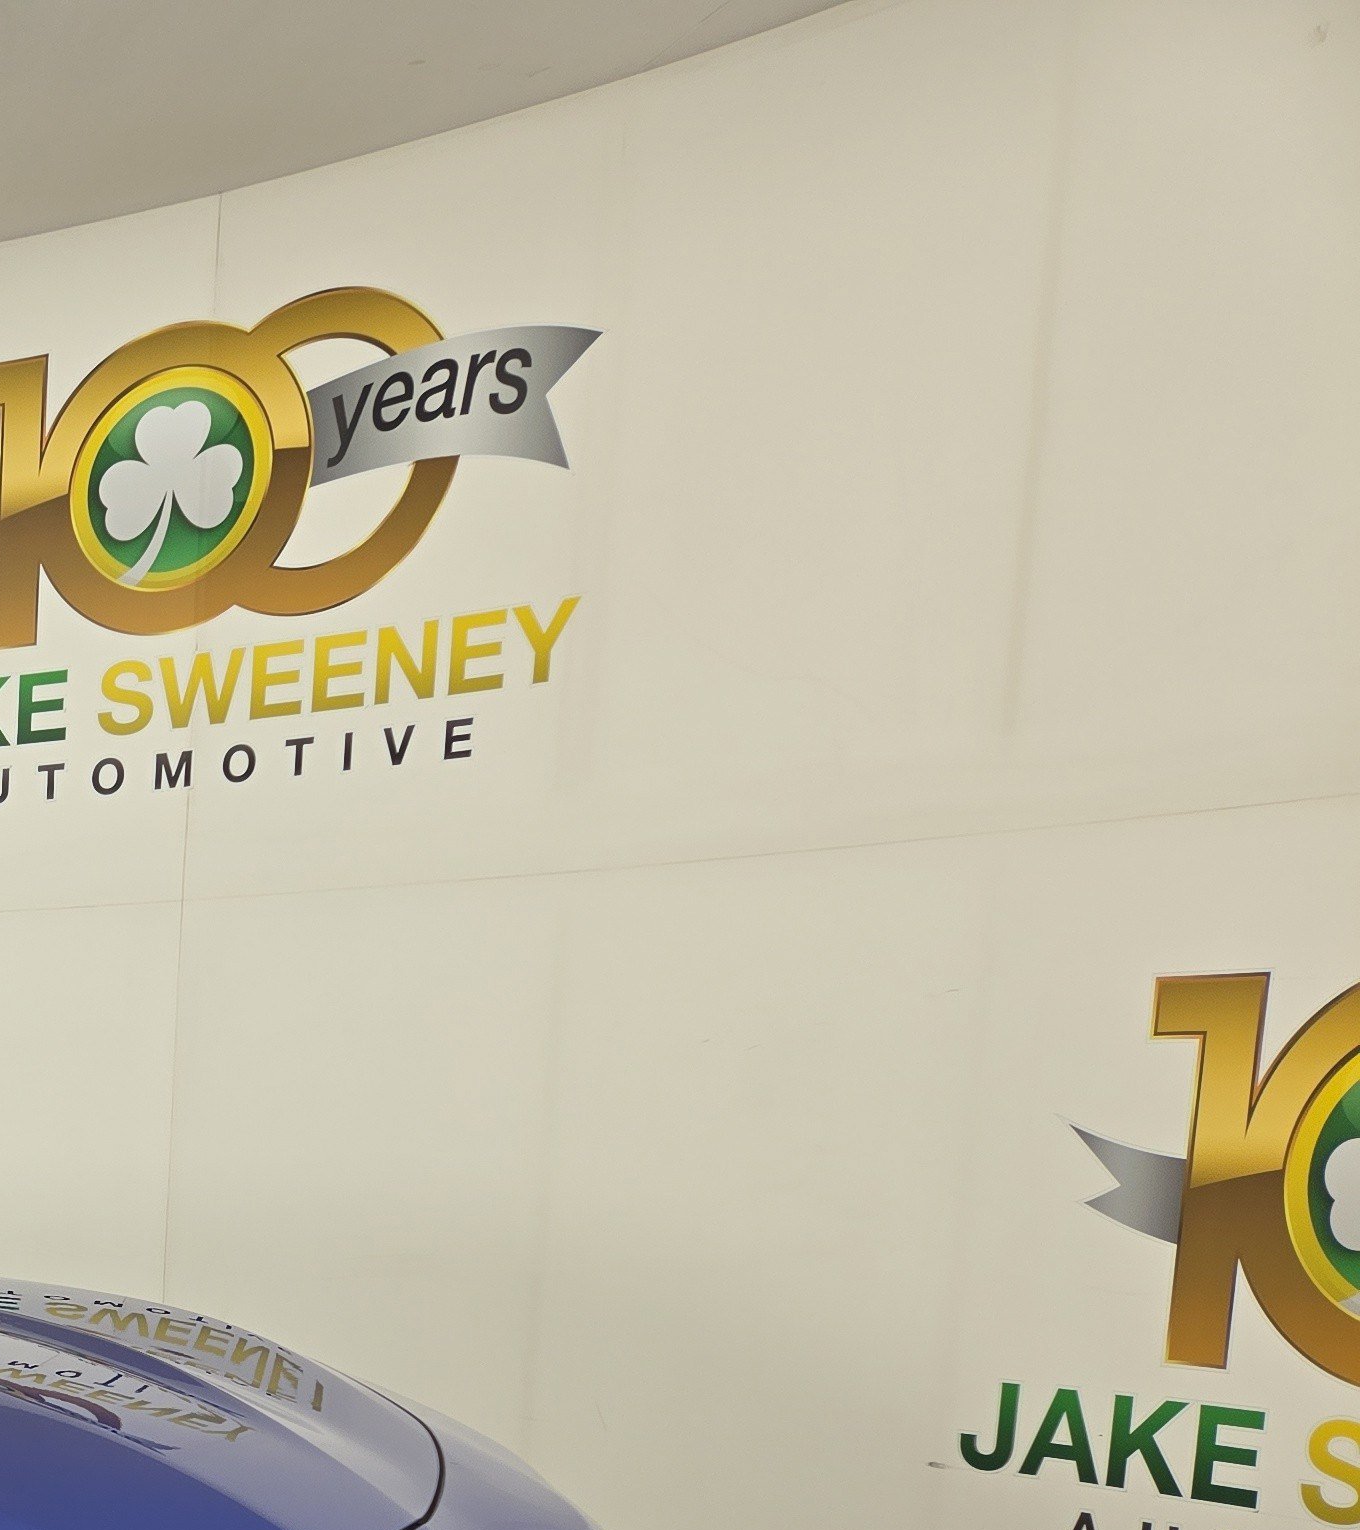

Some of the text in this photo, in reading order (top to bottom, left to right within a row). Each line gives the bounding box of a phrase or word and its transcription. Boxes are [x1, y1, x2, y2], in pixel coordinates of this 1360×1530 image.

[328, 345, 532, 468] years
[98, 596, 582, 737] SWEENEY
[959, 1382, 1265, 1509] JAKE
